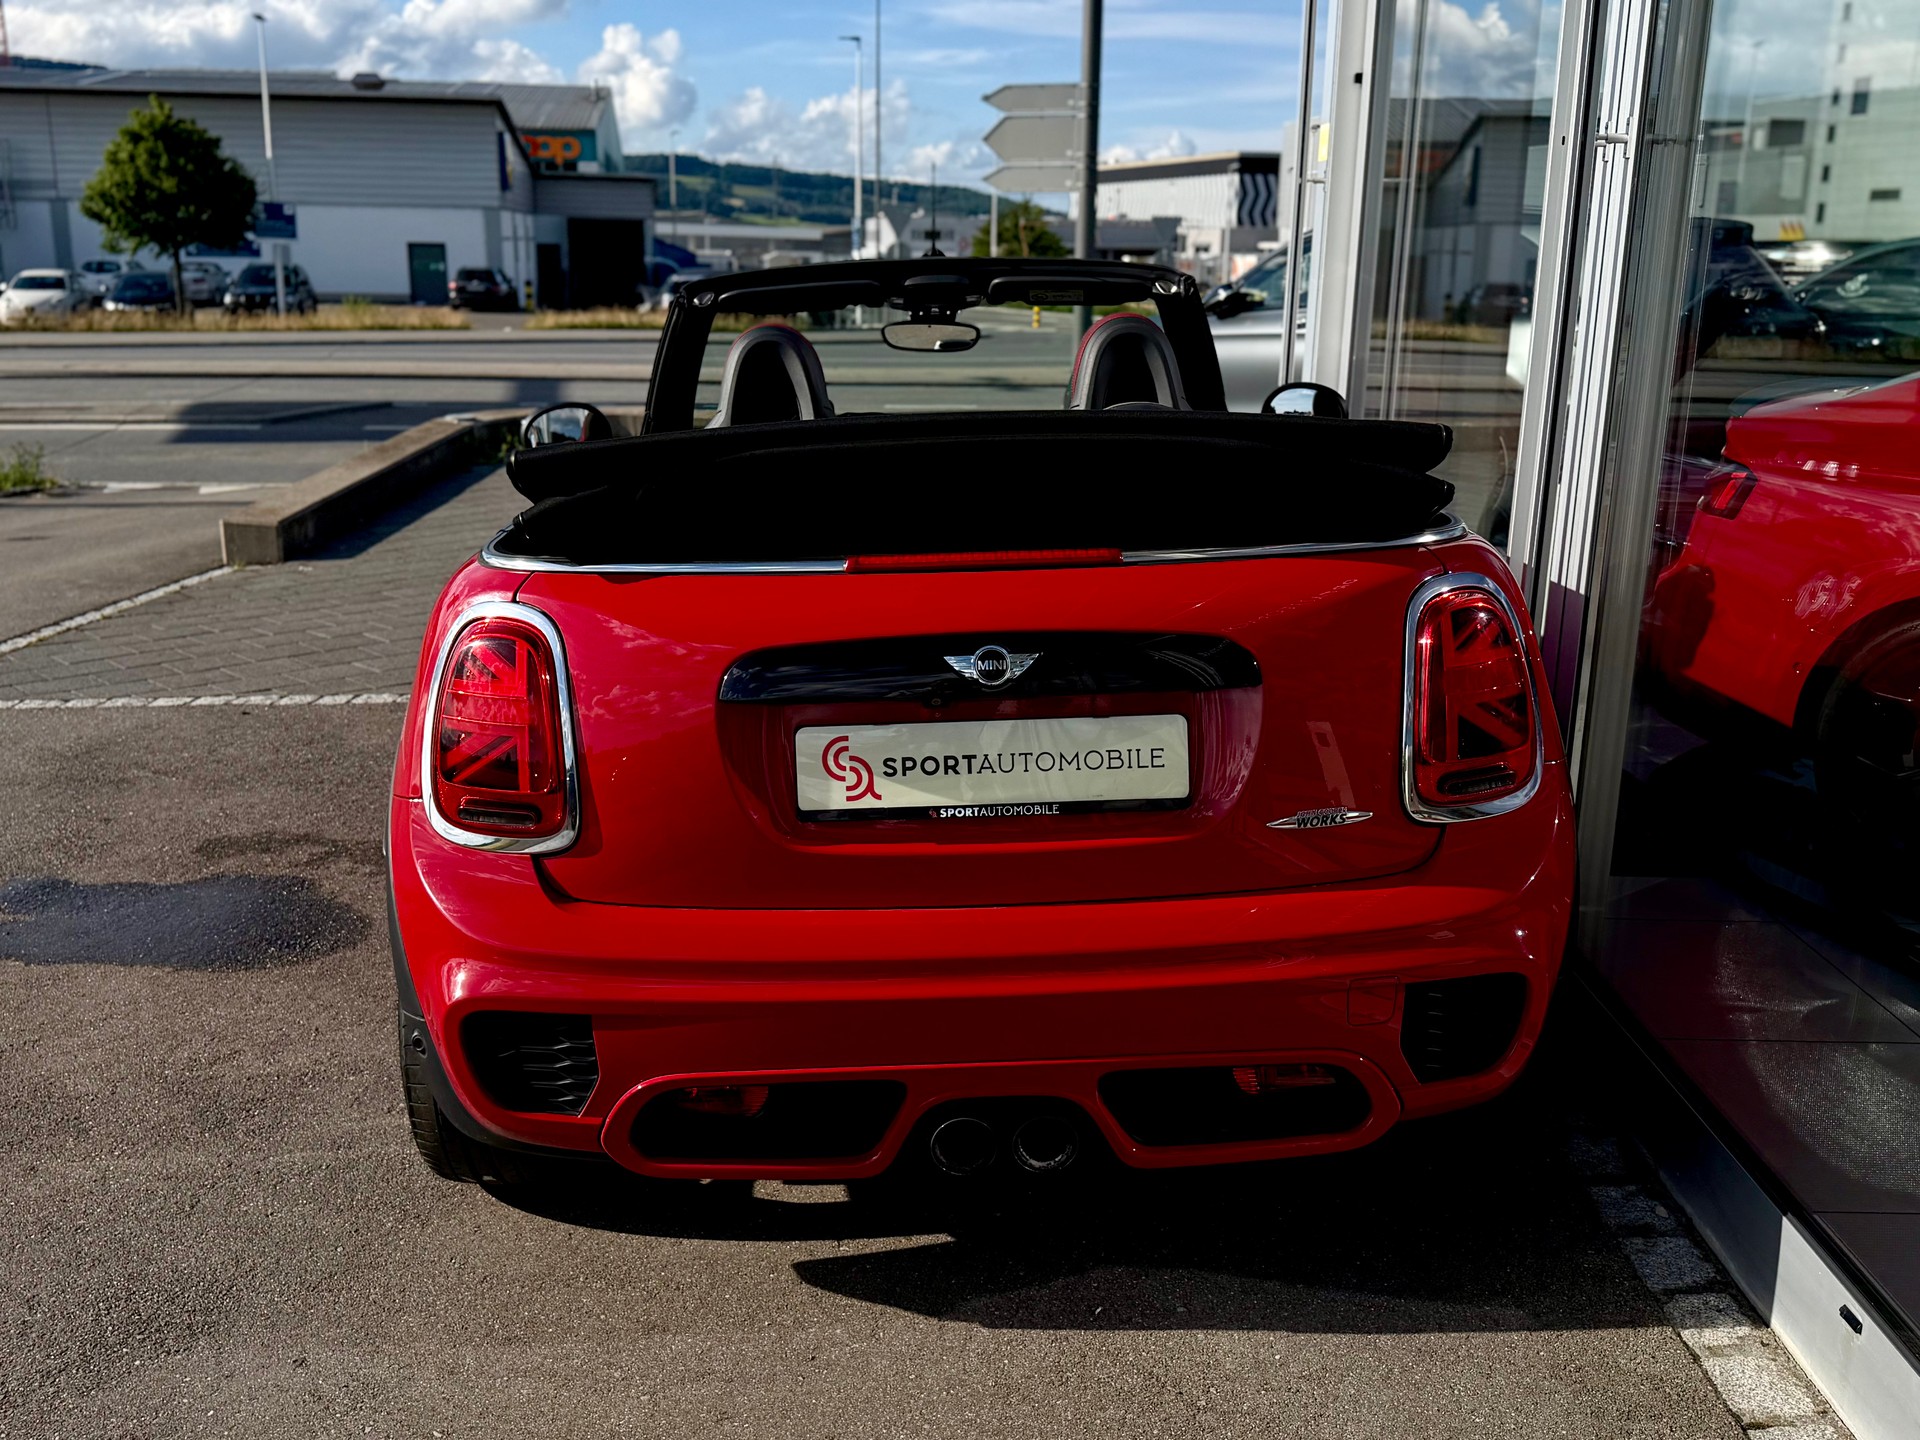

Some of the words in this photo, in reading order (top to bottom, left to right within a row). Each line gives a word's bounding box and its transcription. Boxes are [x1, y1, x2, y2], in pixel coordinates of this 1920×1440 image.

[977, 660, 1007, 671] MINI
[882, 748, 1165, 777] SPORTAUTOMOBILE
[940, 804, 1060, 818] SPORTAUTOMOBILE
[1296, 813, 1348, 828] WORKS
